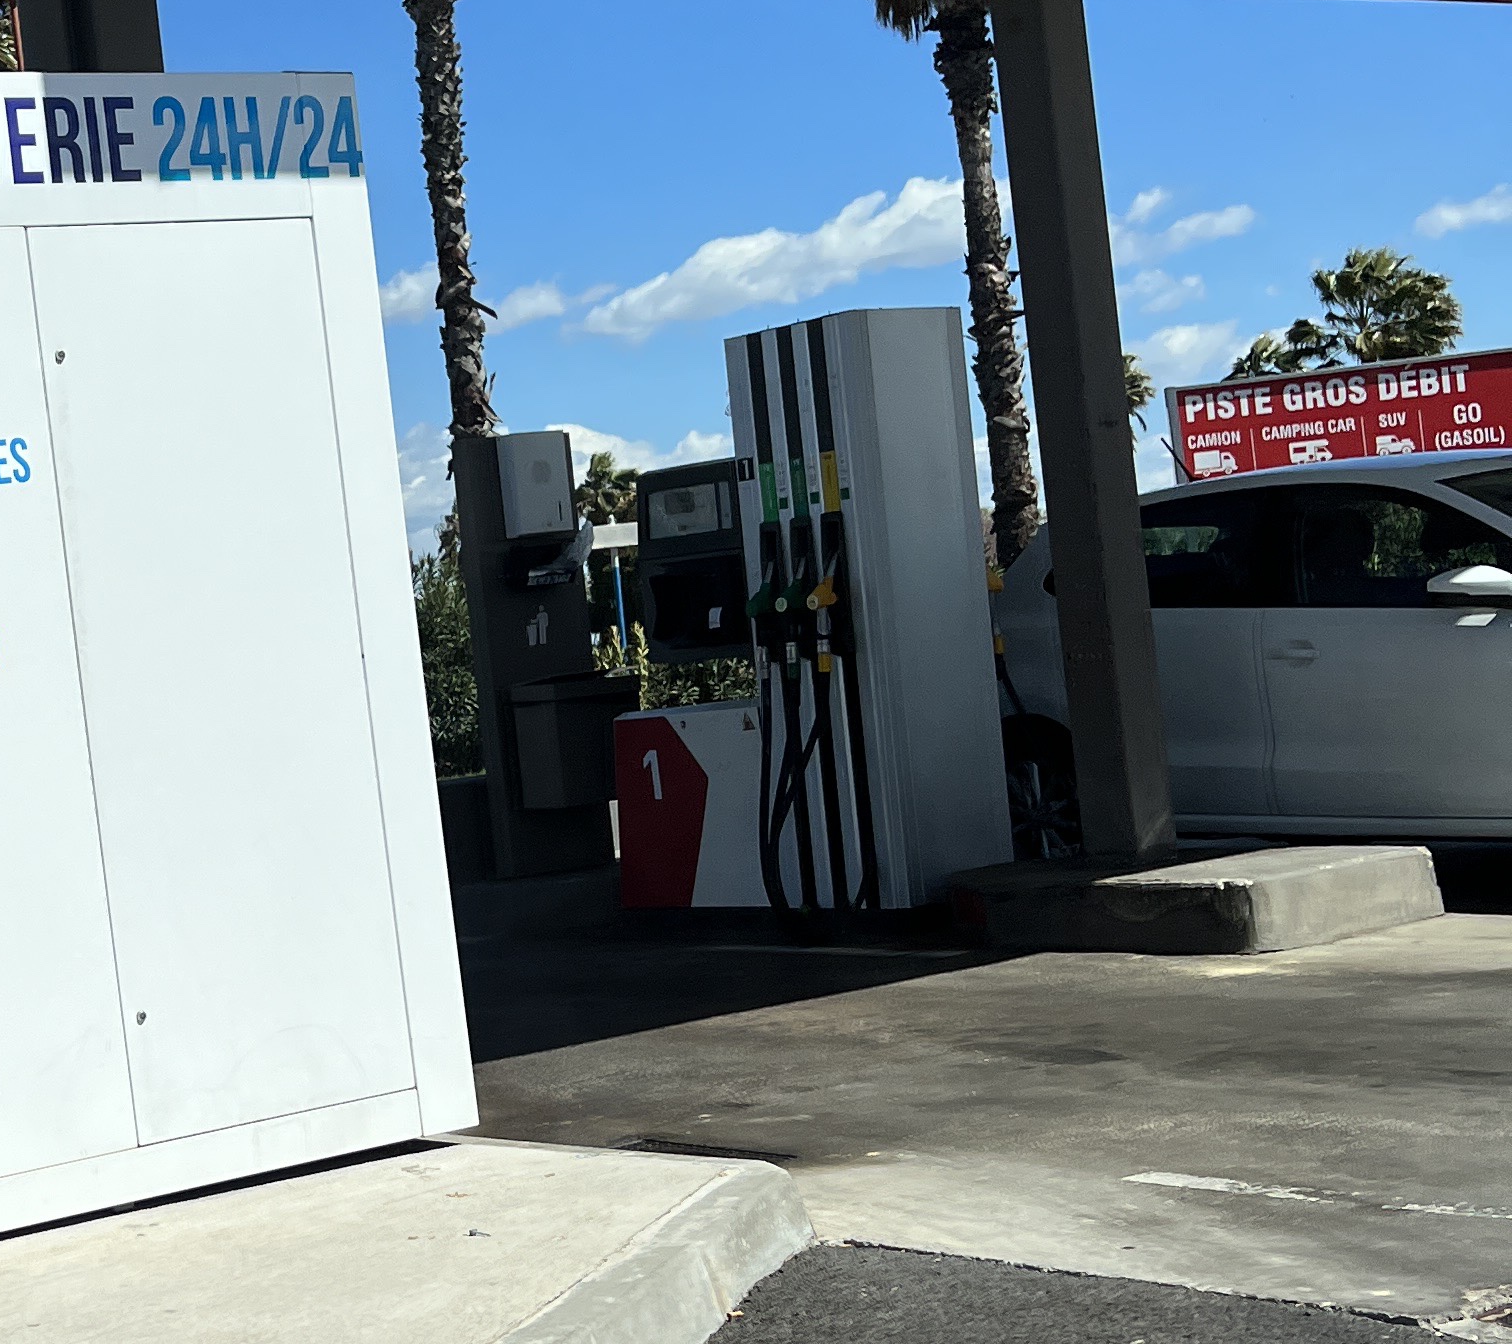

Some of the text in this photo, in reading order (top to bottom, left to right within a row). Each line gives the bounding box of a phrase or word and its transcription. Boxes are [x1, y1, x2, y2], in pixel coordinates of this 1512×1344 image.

[152, 94, 363, 183] 24H/24
[1184, 363, 1470, 423] PISTE GROS DÉBIT
[1378, 411, 1407, 428] SUV
[1453, 402, 1482, 425] GO
[1187, 430, 1241, 450] CAMION
[1261, 416, 1356, 441] CAMPING CAR
[1434, 425, 1506, 451] (GASOIL)
[642, 749, 663, 800] 1
